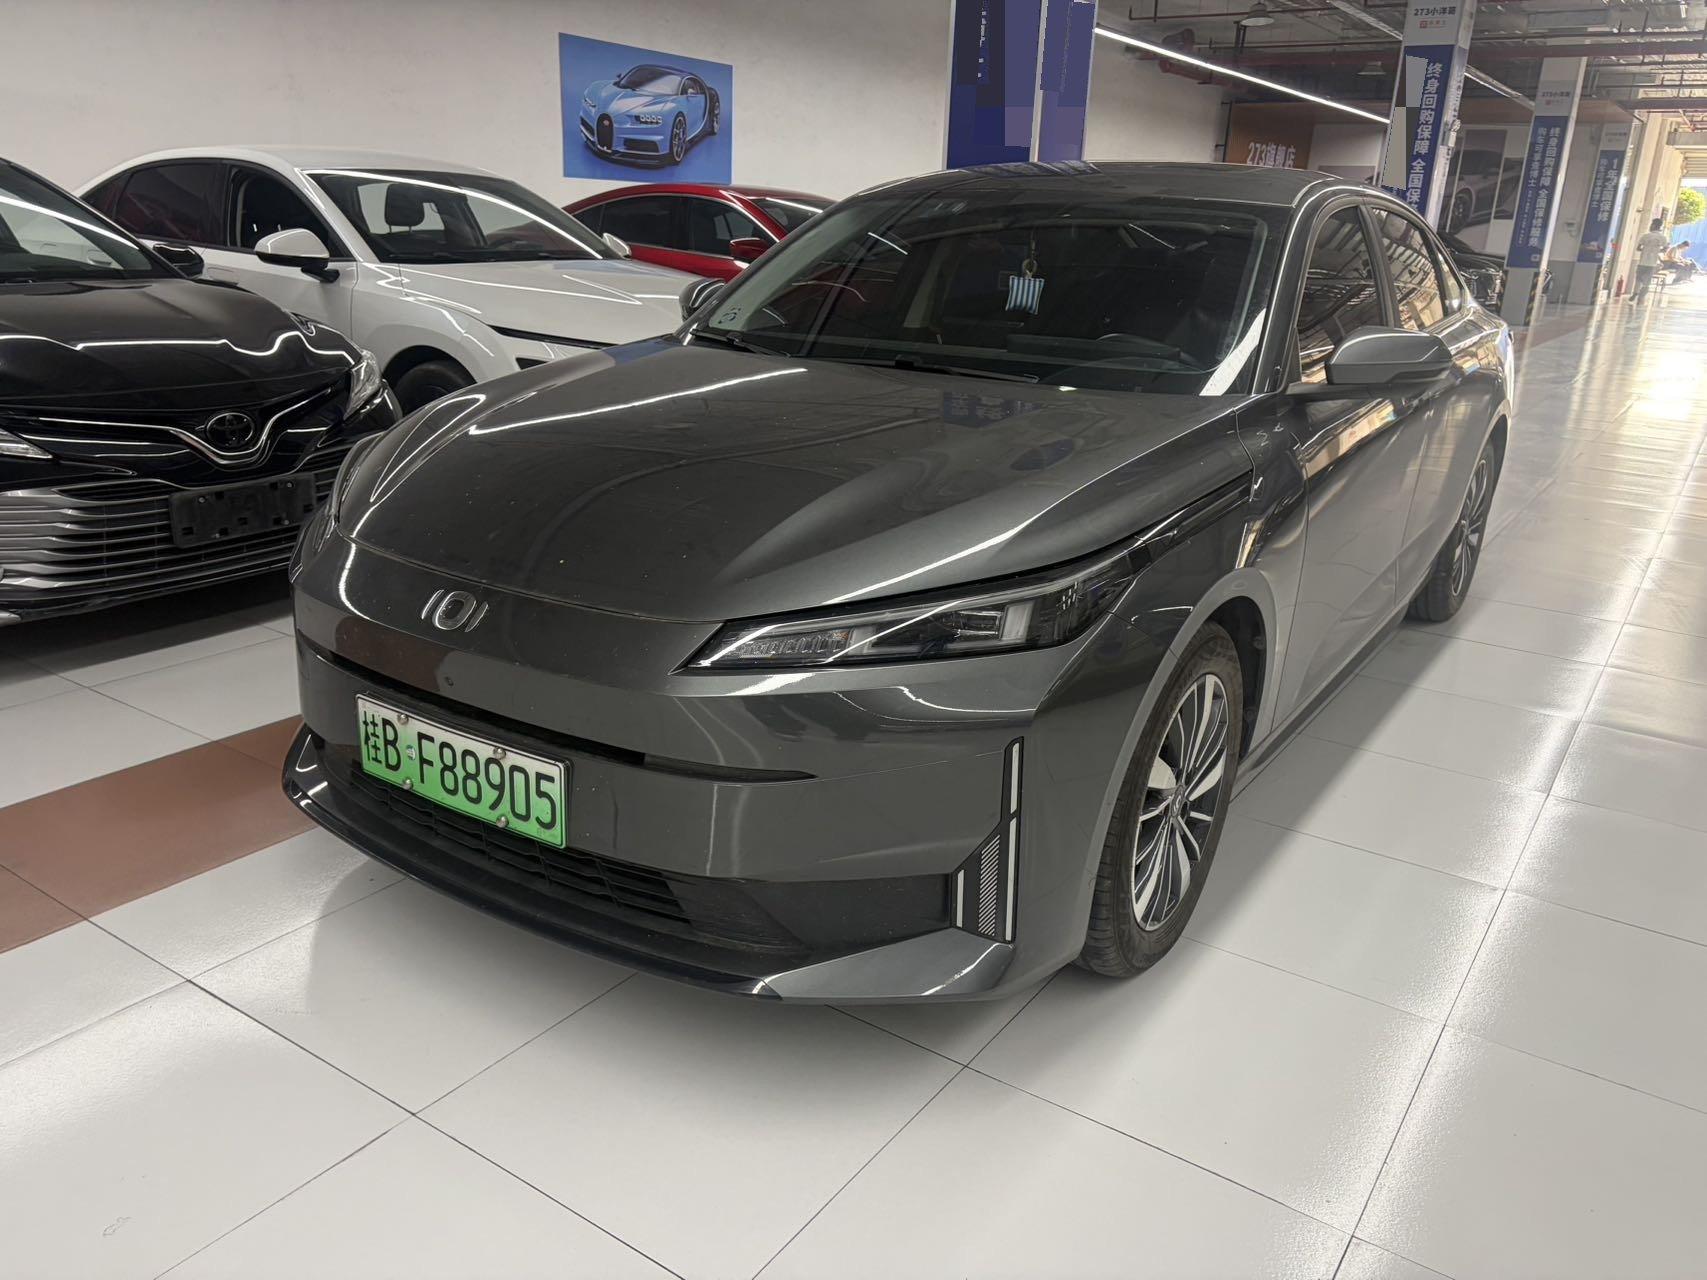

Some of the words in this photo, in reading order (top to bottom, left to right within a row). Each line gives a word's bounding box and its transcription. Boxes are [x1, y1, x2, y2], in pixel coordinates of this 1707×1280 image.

[1413, 62, 1443, 155] 终身回购保障
